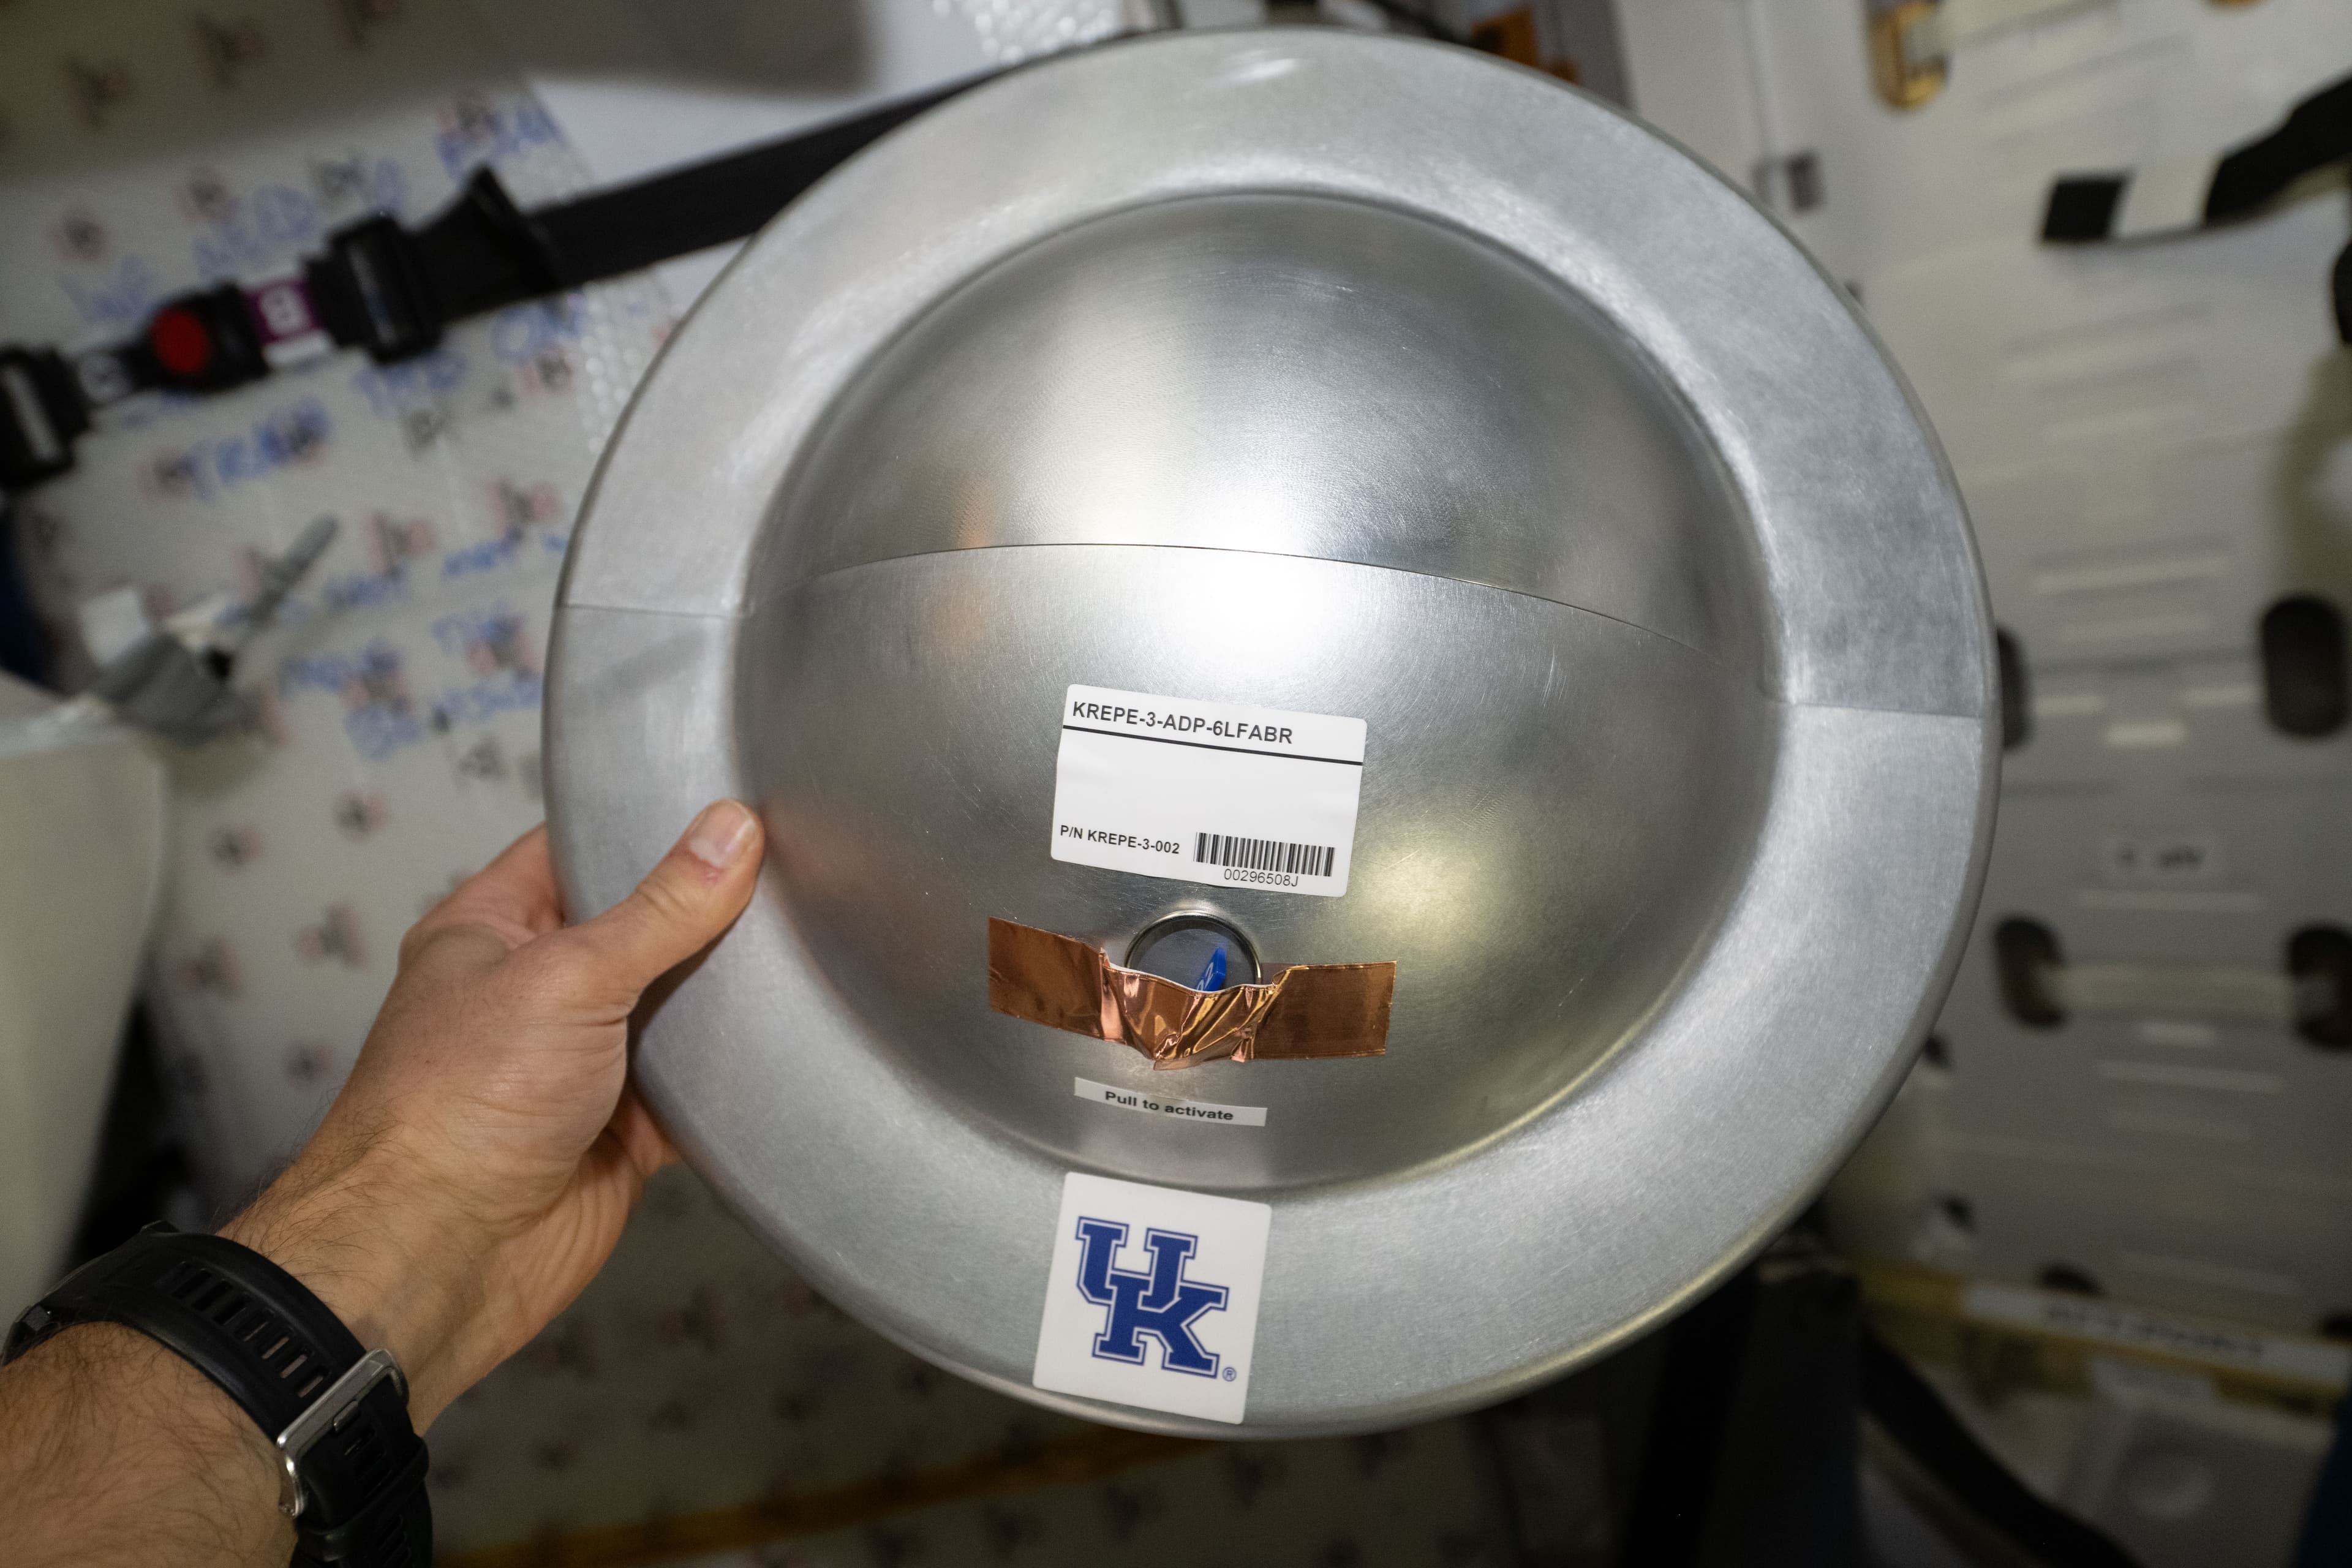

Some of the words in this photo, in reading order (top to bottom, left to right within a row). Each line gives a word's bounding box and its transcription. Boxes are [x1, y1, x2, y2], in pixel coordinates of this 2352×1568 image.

[1072, 701, 1292, 744] KREPE-3-ADP-6LFABR
[1060, 824, 1083, 839] P/N
[1088, 830, 1180, 854] KREPE-3-002
[1224, 869, 1298, 887] 00296508J
[1106, 1091, 1137, 1106] Pull
[1143, 1100, 1159, 1111] to
[1165, 1105, 1233, 1120] activate
[1075, 1216, 1229, 1379] UK
